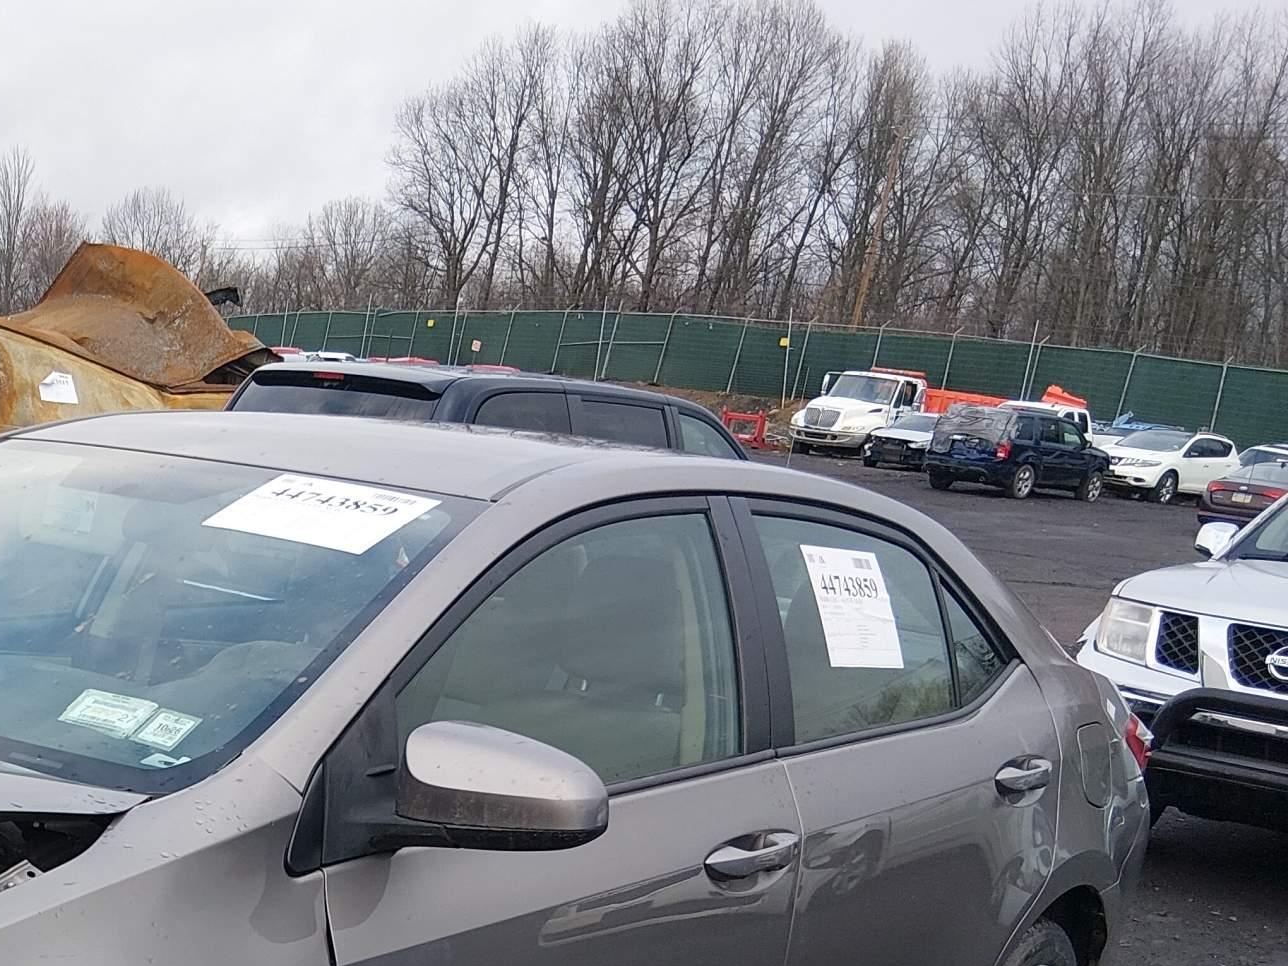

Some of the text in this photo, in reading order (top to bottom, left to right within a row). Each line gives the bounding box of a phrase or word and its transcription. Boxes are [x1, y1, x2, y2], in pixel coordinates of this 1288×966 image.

[271, 488, 399, 515] 44743859
[821, 573, 878, 598] 44743859
[1270, 656, 1288, 665] NIS
